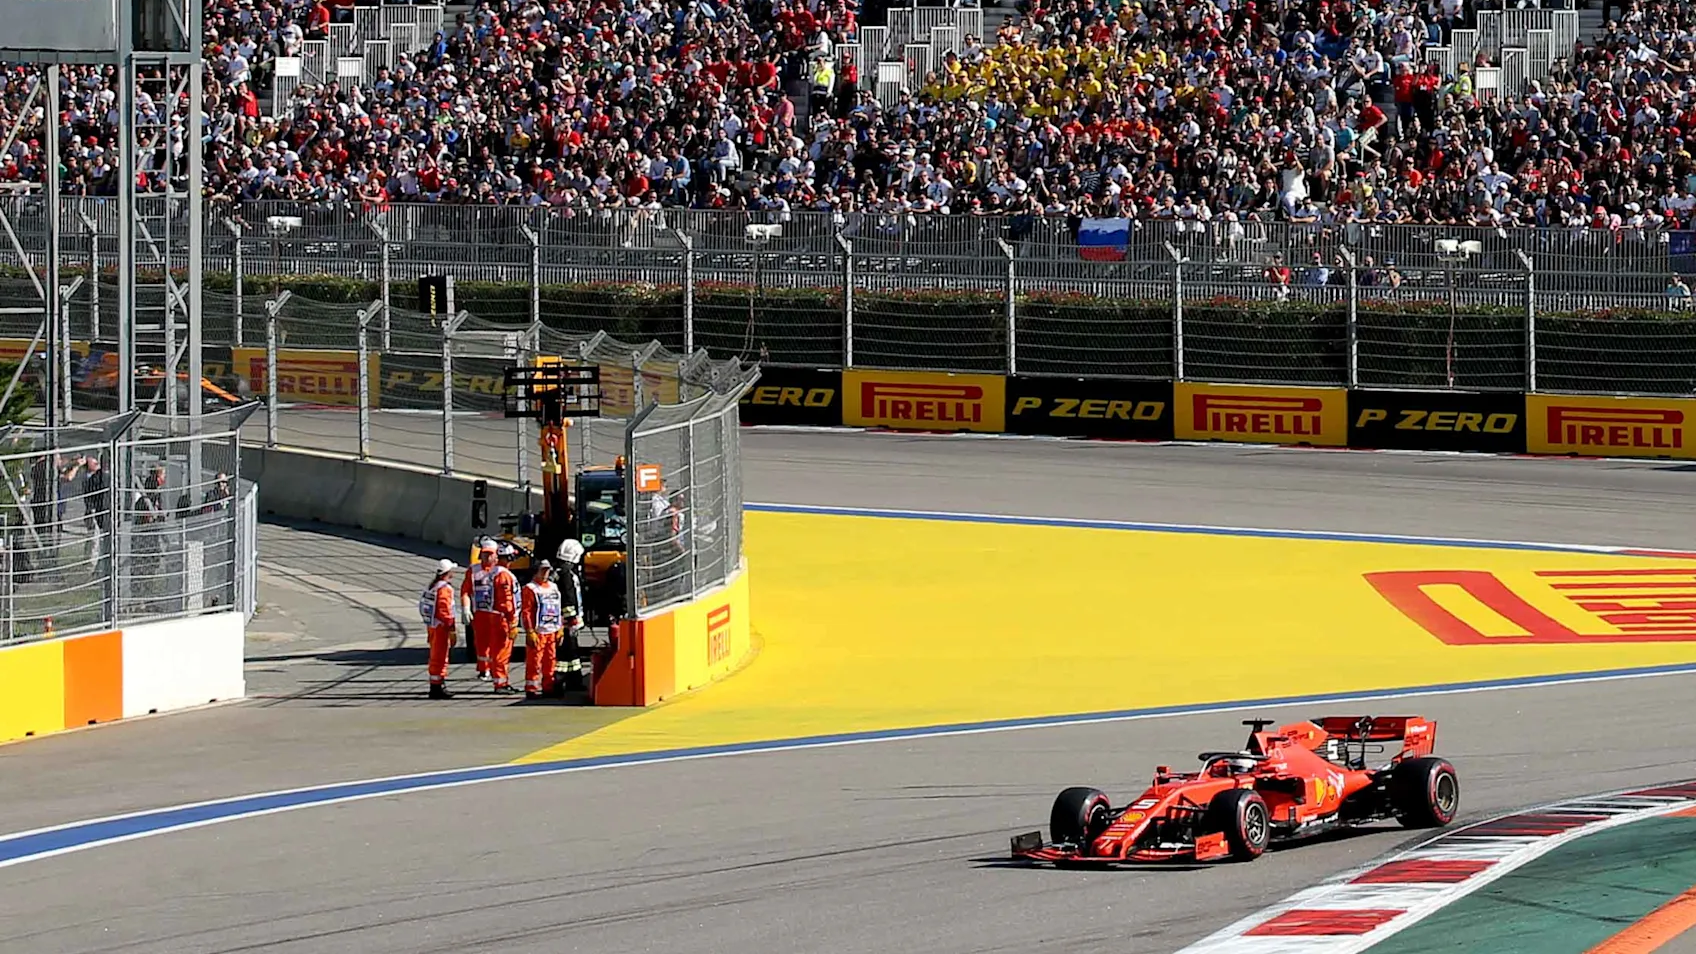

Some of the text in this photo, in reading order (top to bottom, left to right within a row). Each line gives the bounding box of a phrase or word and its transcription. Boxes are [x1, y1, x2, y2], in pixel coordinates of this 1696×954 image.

[249, 357, 359, 397] PRELLI
[861, 382, 983, 423] PIRELLI
[1012, 397, 1165, 421] P ZERO
[1192, 394, 1323, 435] PIRELLI
[1356, 409, 1518, 433] P ZERO
[1547, 406, 1684, 448] PIRELLI
[640, 469, 658, 487] F
[1327, 738, 1340, 761] 5
[1131, 798, 1161, 810] 5
